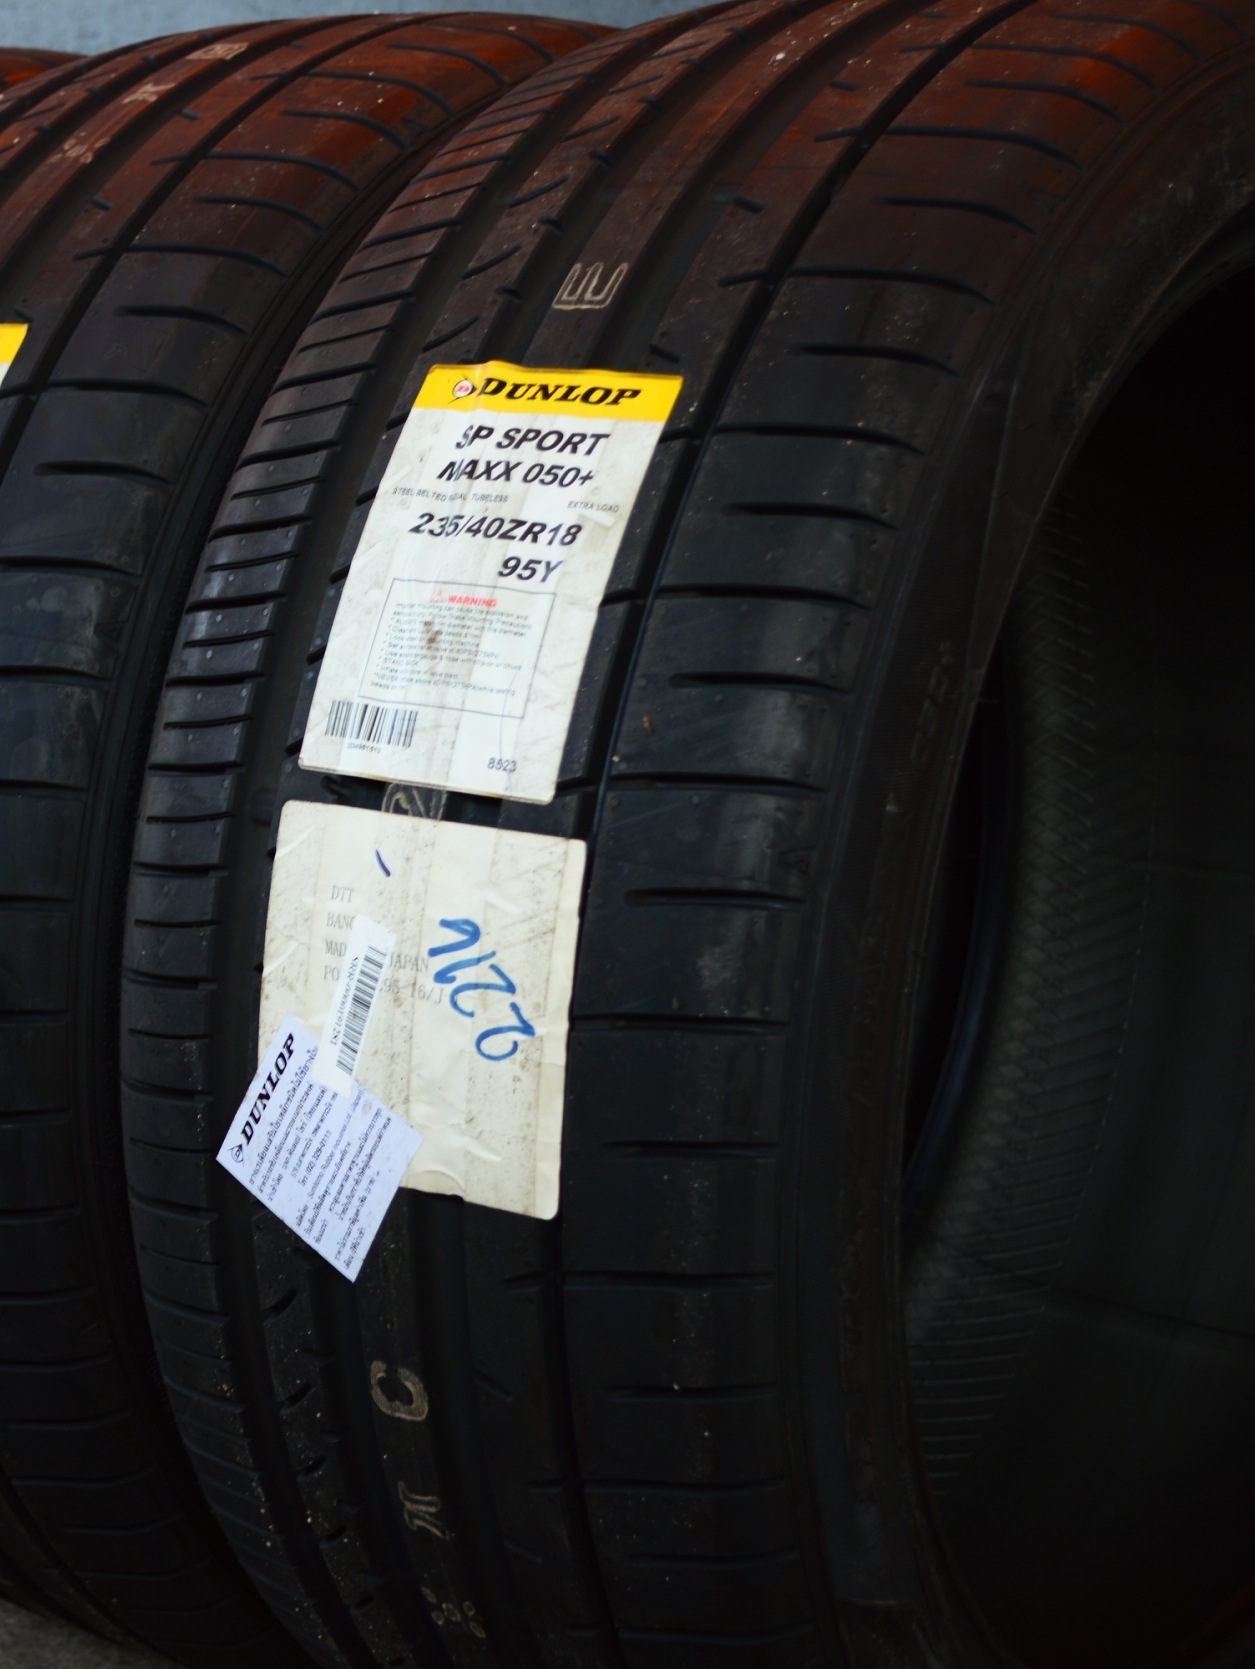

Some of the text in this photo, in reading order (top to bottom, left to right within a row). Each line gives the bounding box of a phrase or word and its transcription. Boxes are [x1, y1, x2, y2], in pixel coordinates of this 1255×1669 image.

[477, 377, 642, 406] DUNLOP
[455, 425, 611, 457] SP SPORT
[437, 458, 595, 488] MAXX 050+
[567, 500, 620, 513] EXTRA LOAD
[408, 512, 583, 548] 235/40ZR18
[497, 556, 564, 584] 95Y
[448, 595, 498, 608] WARNING
[486, 757, 518, 774] 8523
[330, 885, 354, 903] DTT
[388, 951, 430, 973] JAPAN
[240, 1032, 295, 1145] DUNLOP
